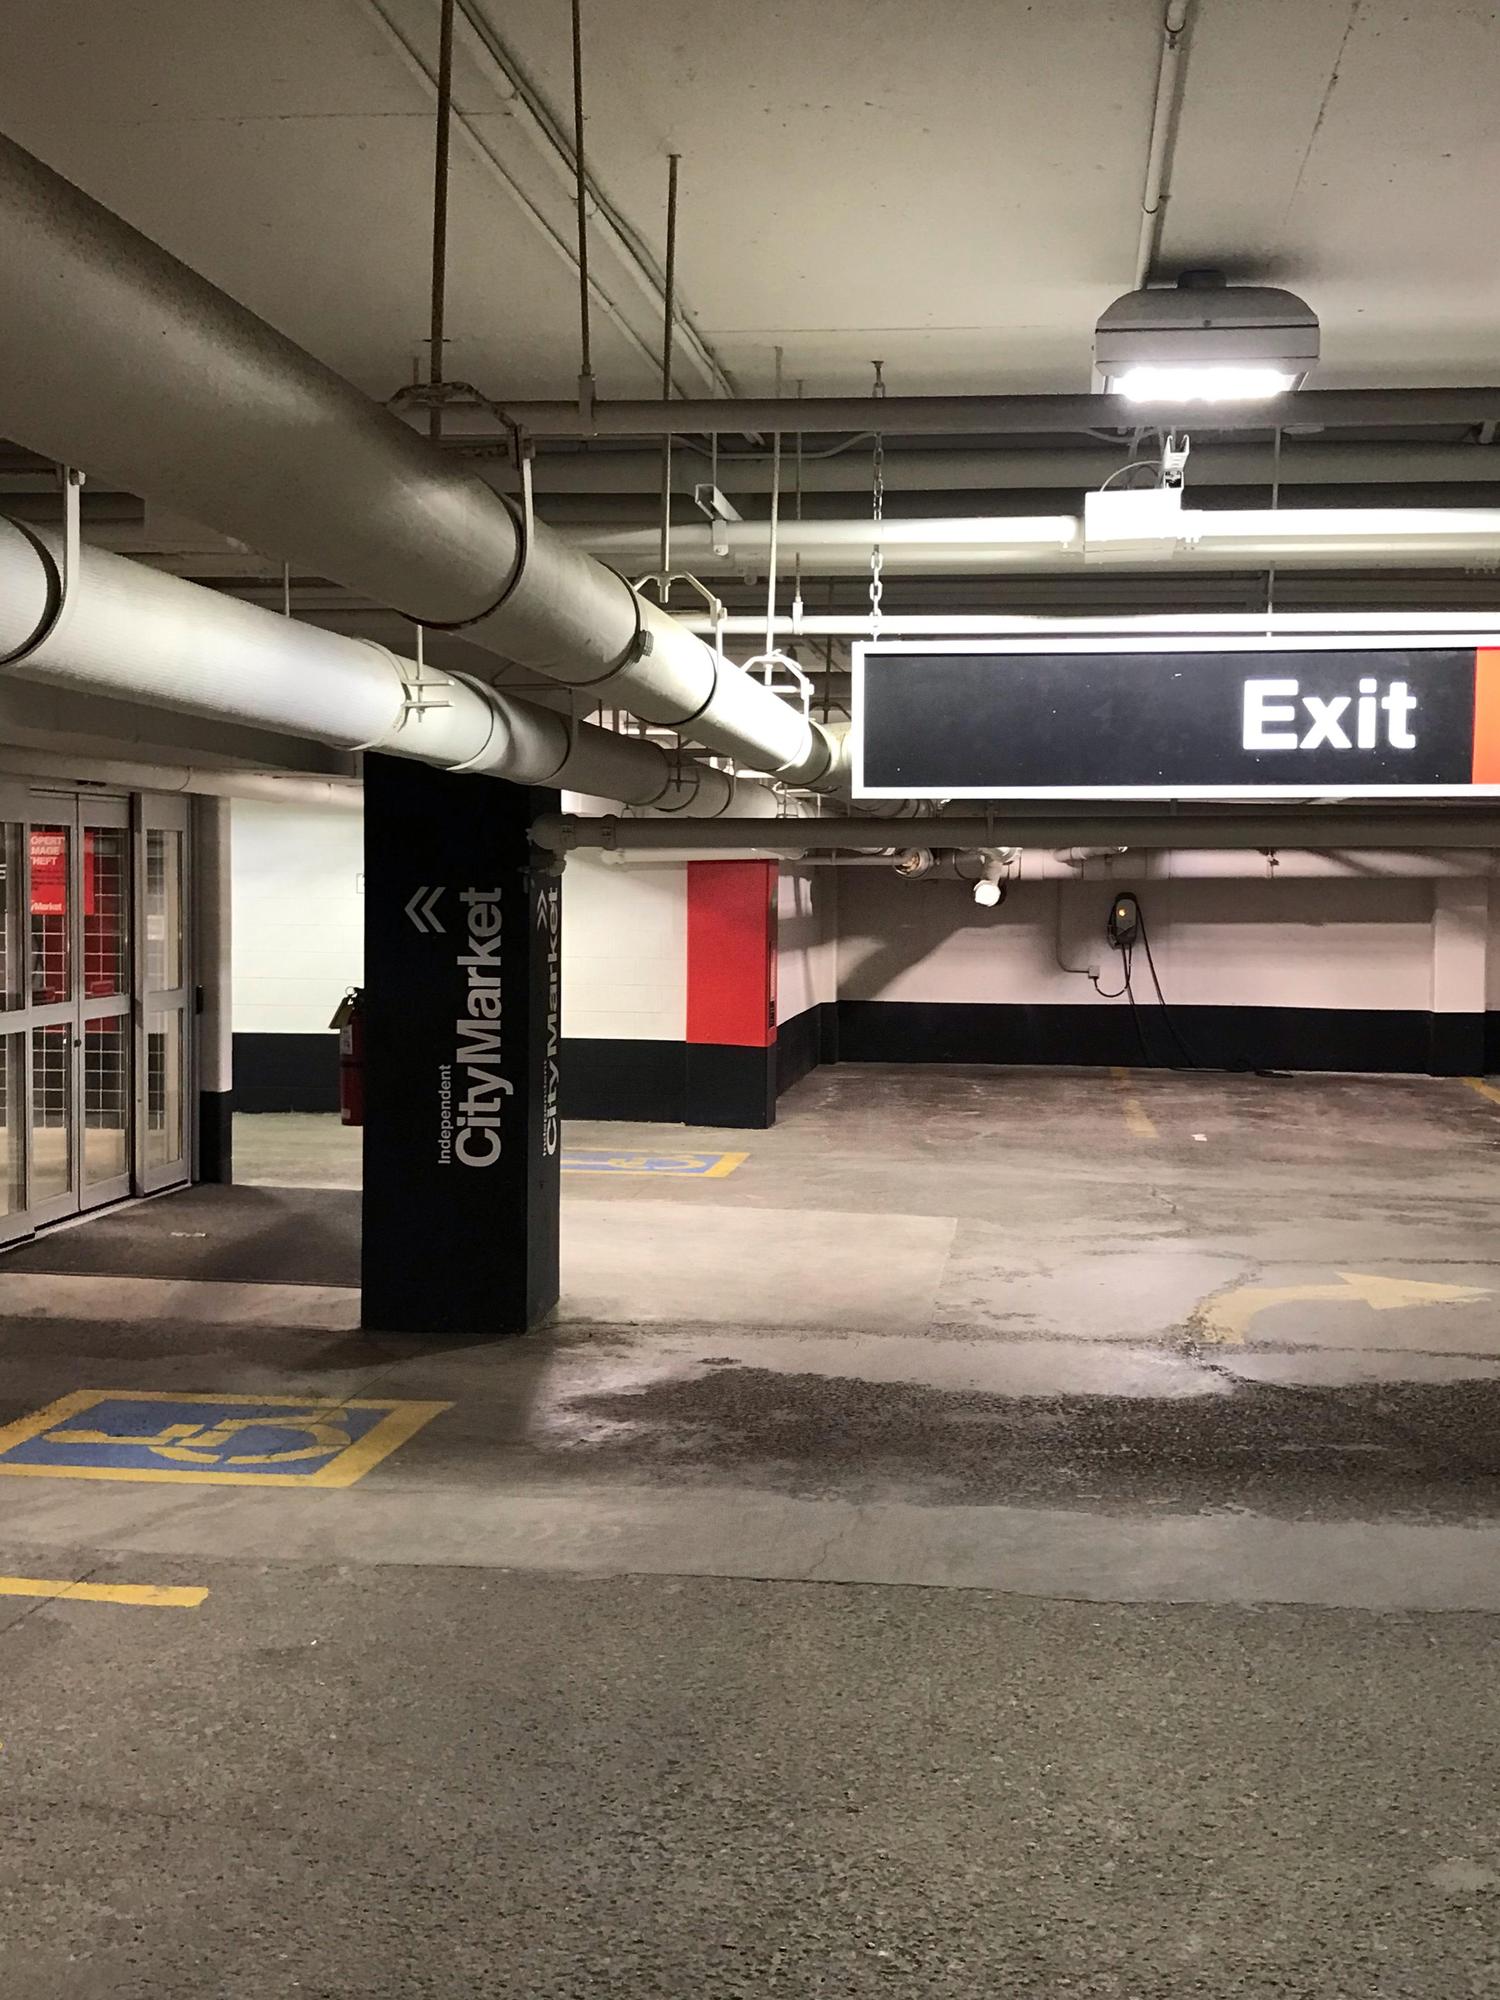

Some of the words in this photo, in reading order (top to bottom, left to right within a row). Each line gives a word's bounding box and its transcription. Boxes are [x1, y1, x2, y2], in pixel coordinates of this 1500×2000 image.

[1242, 678, 1417, 750] Exit
[455, 886, 514, 1168] CityMarket
[438, 1064, 452, 1165] Independent
